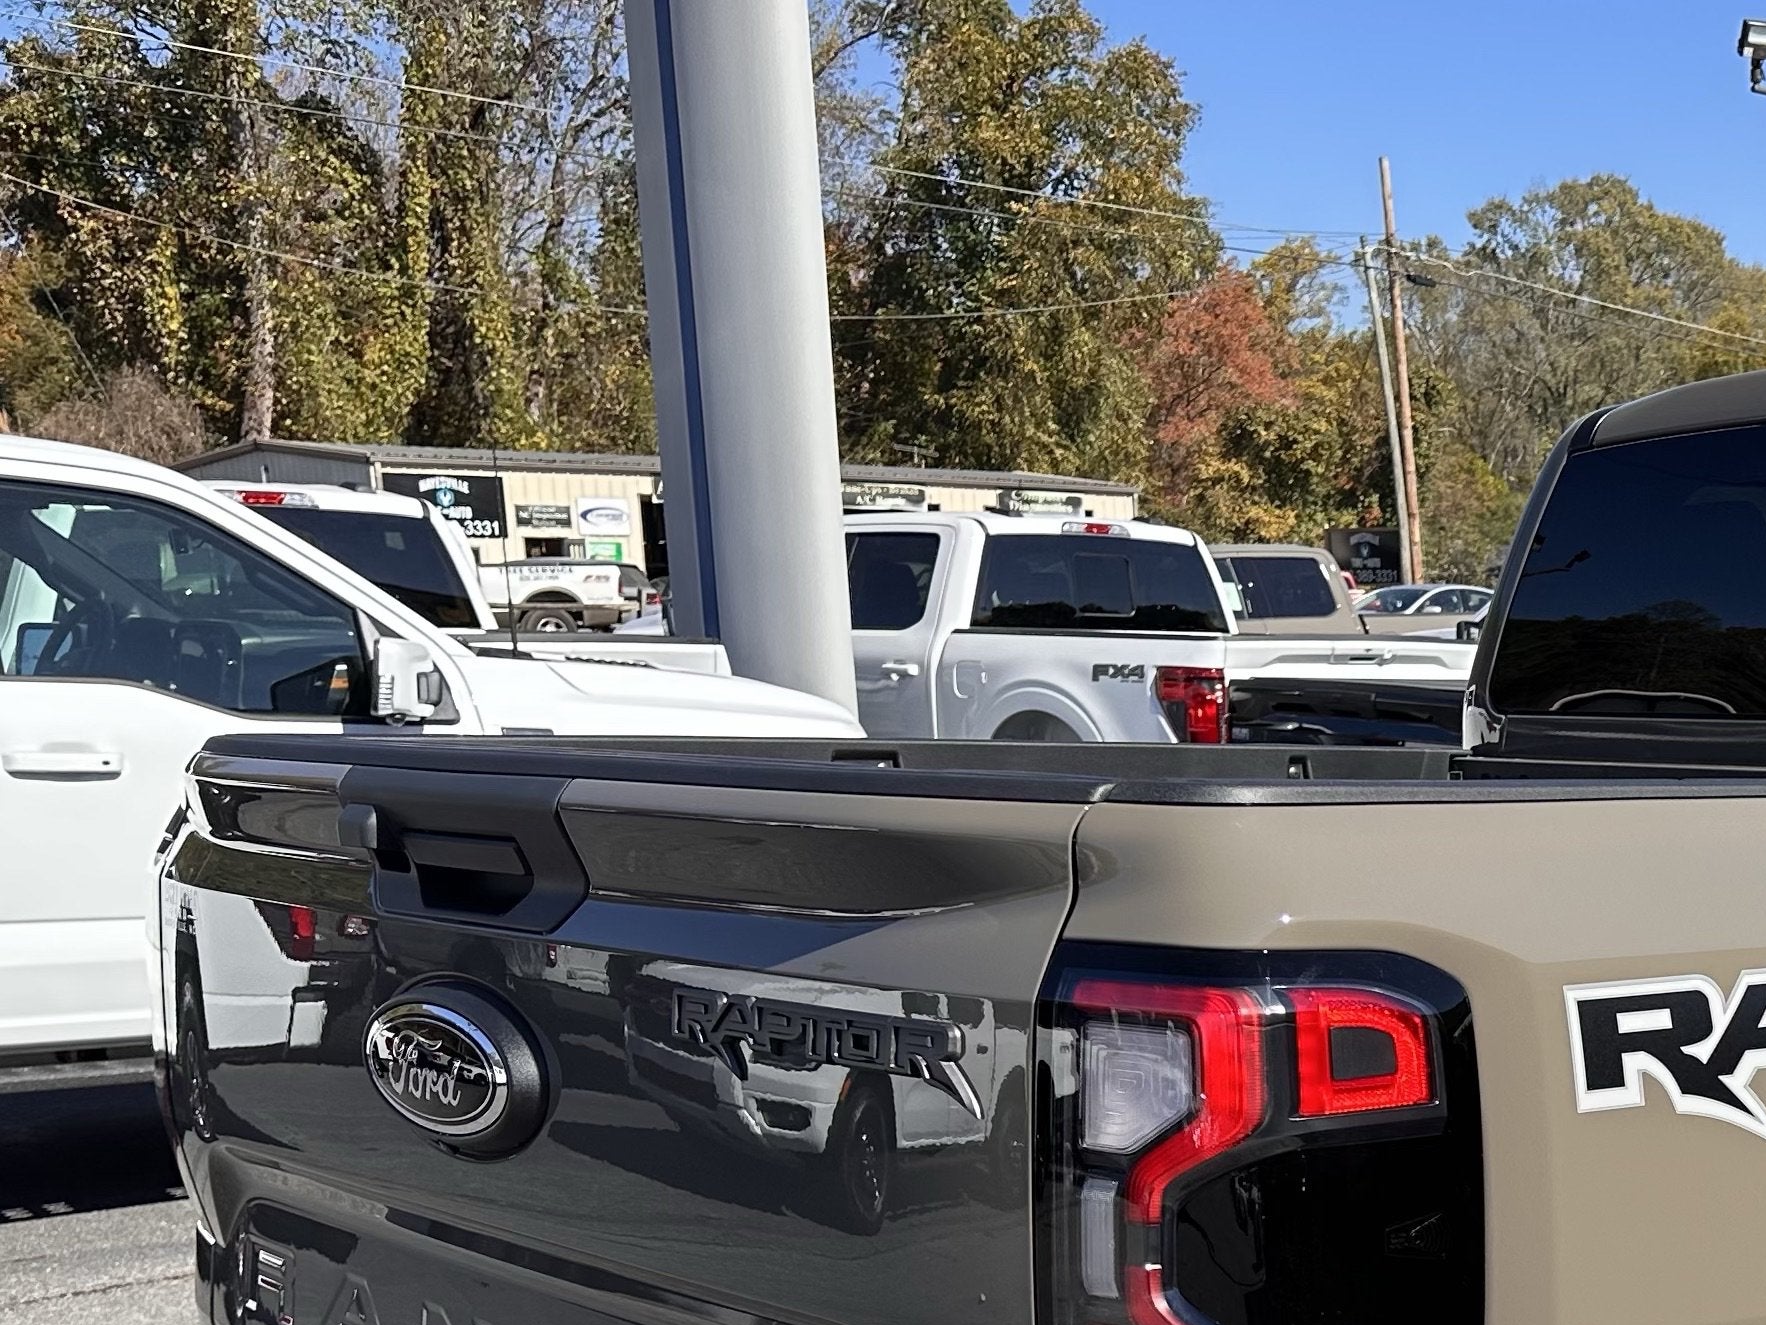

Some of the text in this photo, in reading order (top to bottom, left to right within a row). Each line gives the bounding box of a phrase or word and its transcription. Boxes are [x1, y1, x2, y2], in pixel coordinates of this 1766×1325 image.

[1092, 664, 1144, 681] FX4
[389, 1029, 462, 1107] Ford
[671, 986, 985, 1120] RAPTOR
